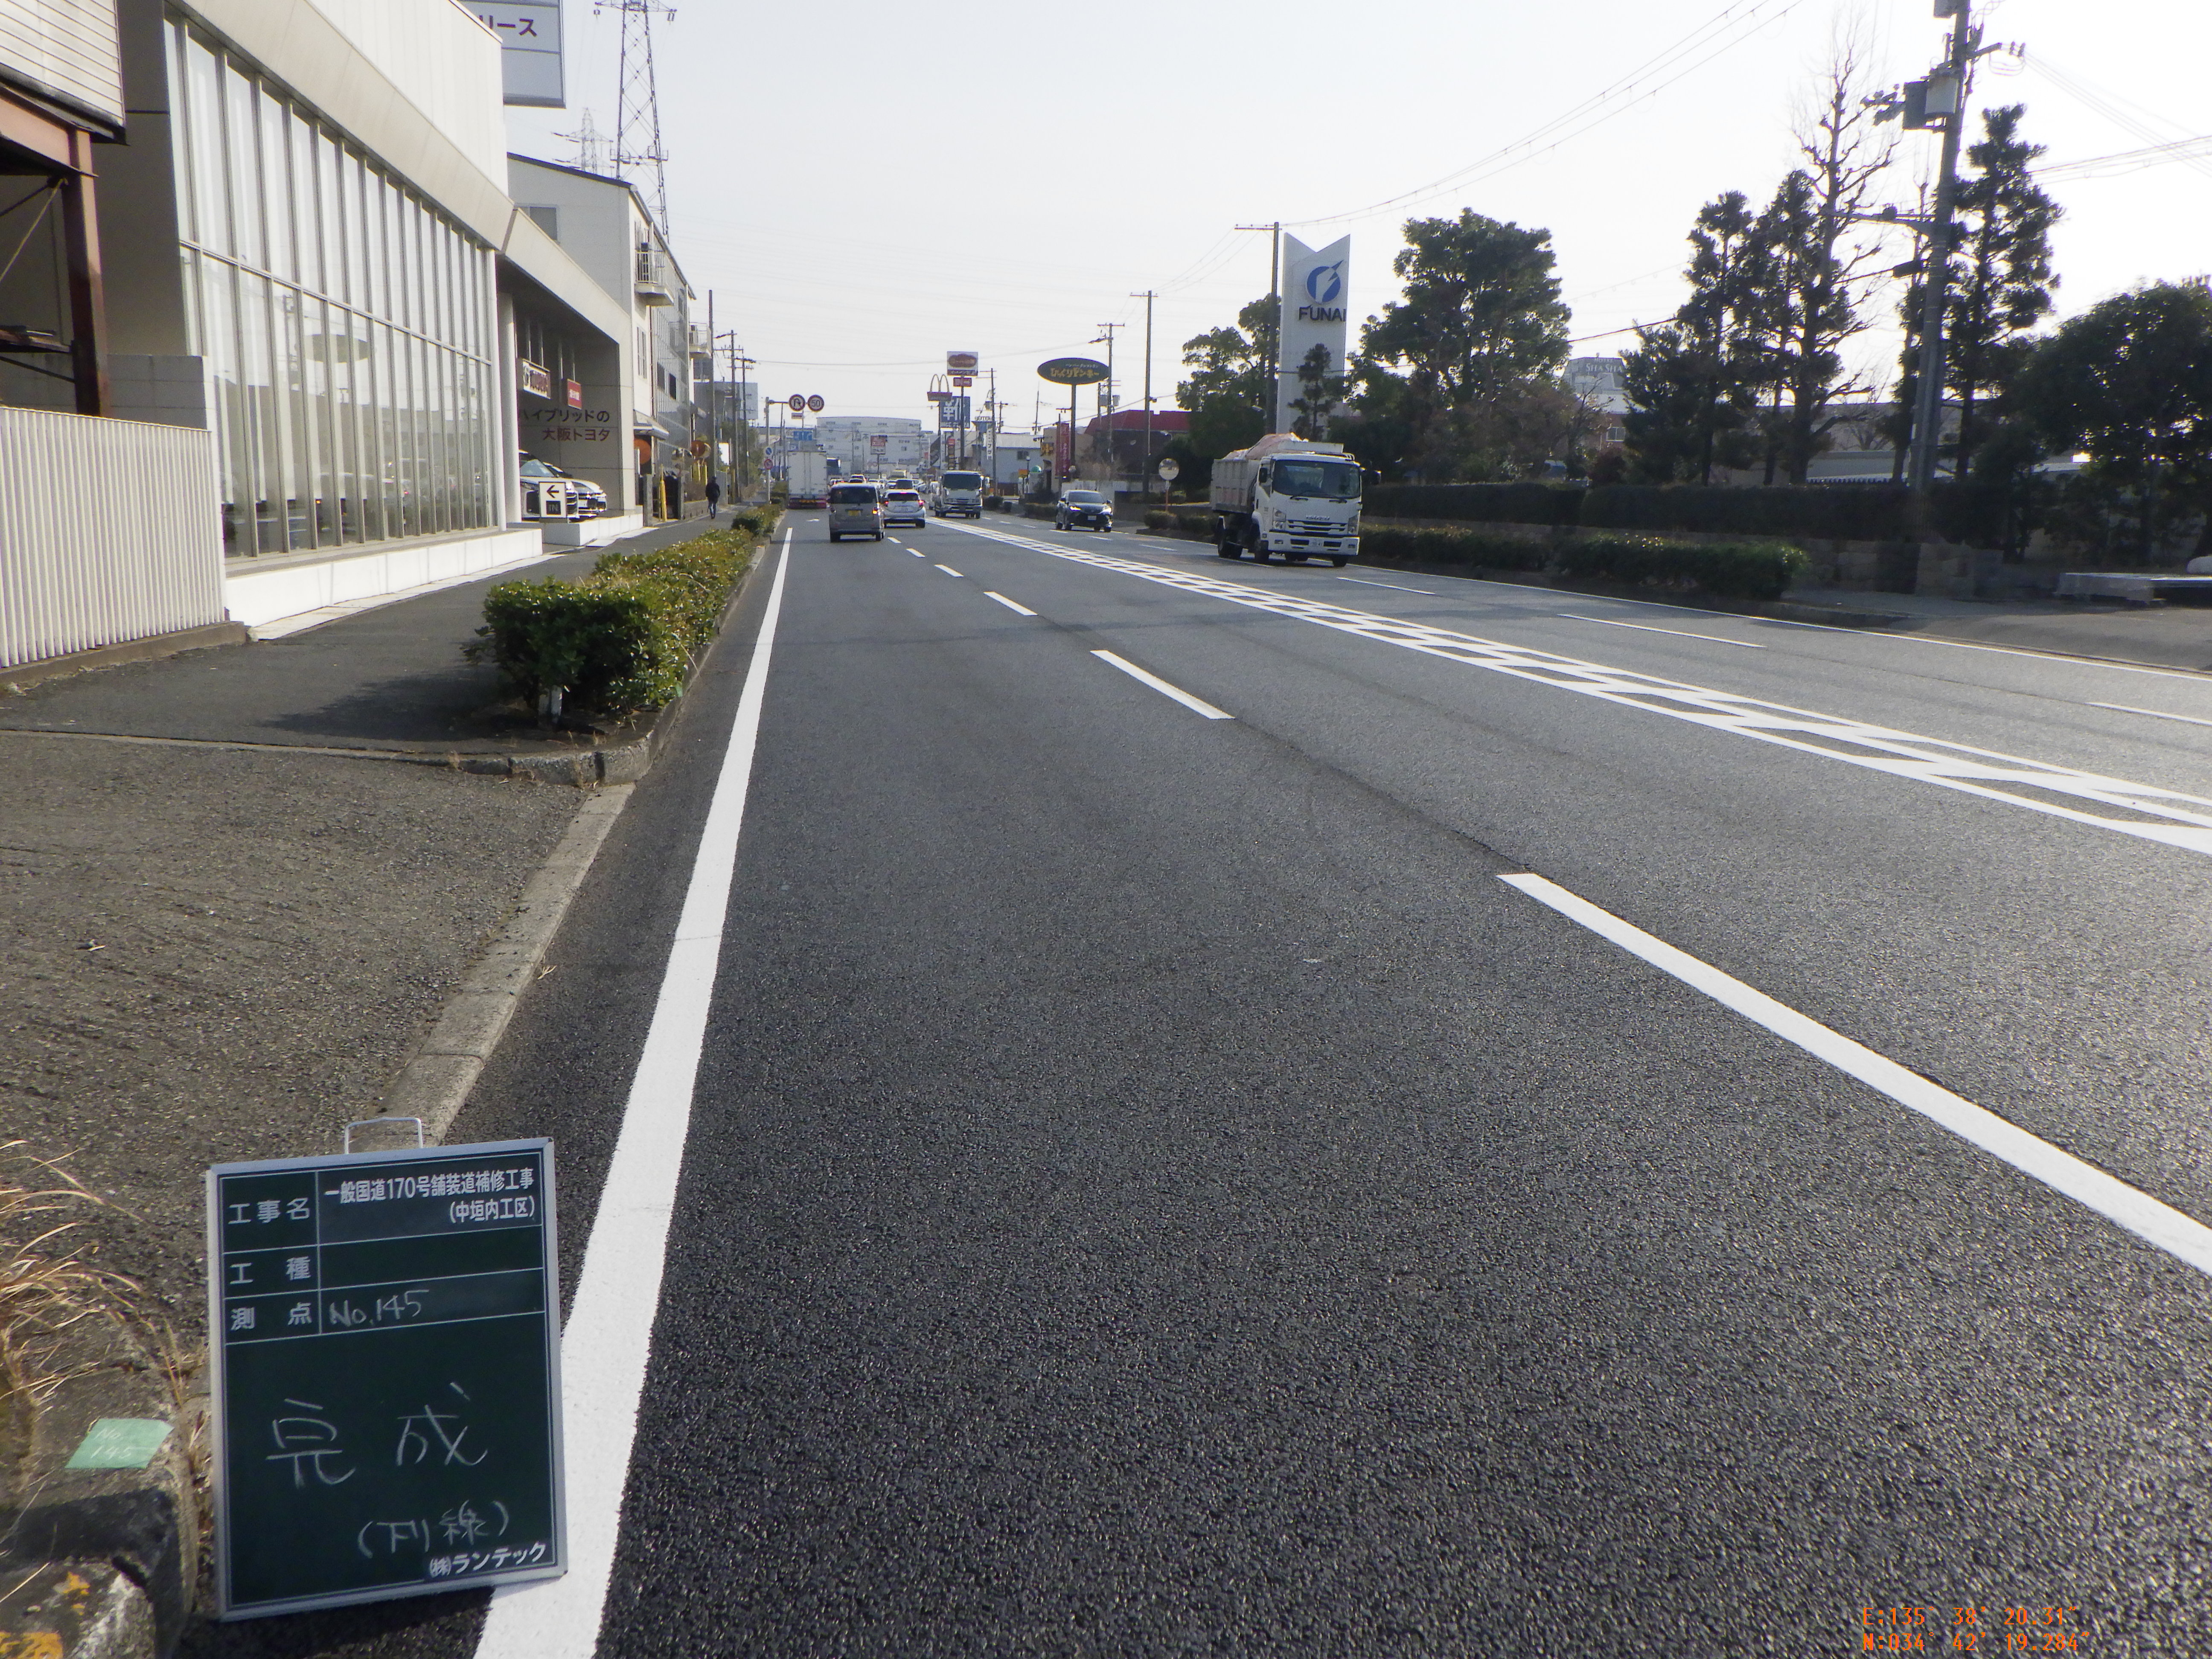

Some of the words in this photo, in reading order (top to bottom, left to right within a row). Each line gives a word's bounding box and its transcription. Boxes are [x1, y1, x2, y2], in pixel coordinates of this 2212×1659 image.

[1298, 304, 1347, 322] FUNAI
[542, 428, 611, 442] 大阪トヨタ
[549, 504, 559, 512] IN
[228, 1197, 311, 1225] 工事名
[449, 1196, 536, 1225] (中垣内工区)
[90, 1446, 133, 1458] 145
